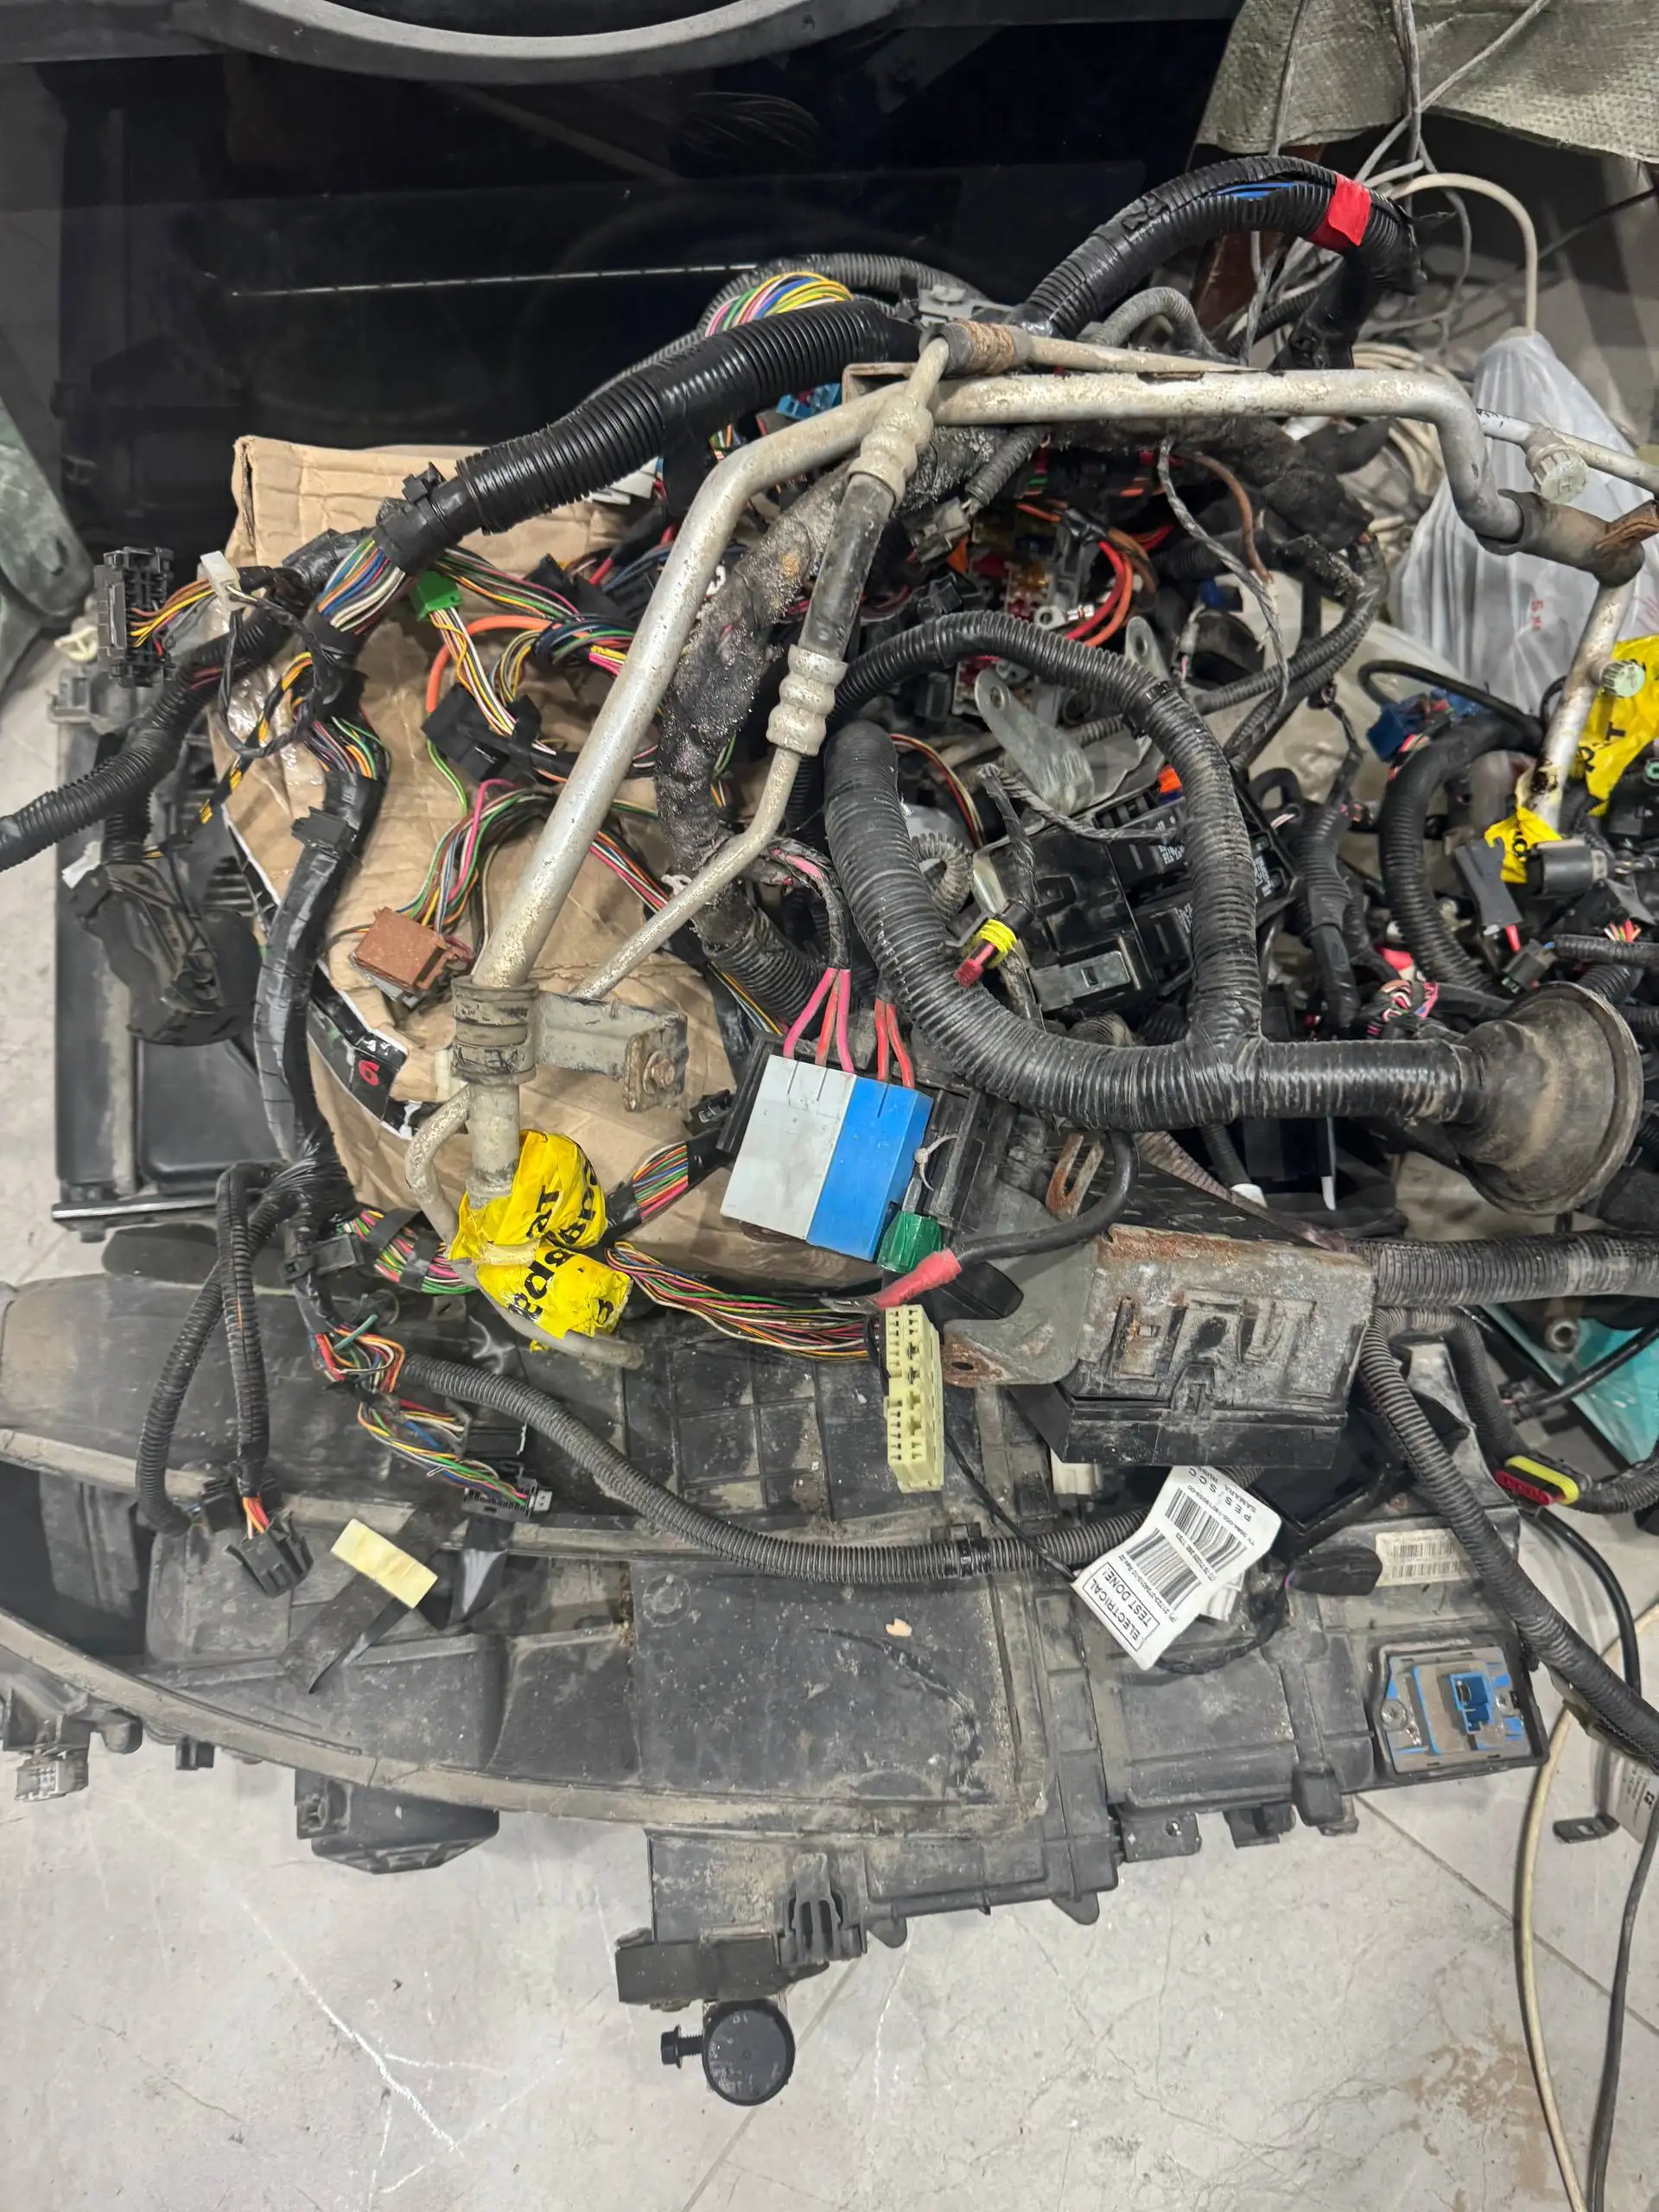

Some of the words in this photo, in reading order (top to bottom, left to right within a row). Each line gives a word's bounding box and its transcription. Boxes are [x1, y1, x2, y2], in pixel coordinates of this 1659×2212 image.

[1102, 1568, 1130, 1601] DONE!
[1090, 1578, 1140, 1640] ELECTRICAL
[1128, 1599, 1151, 1626] TEST
